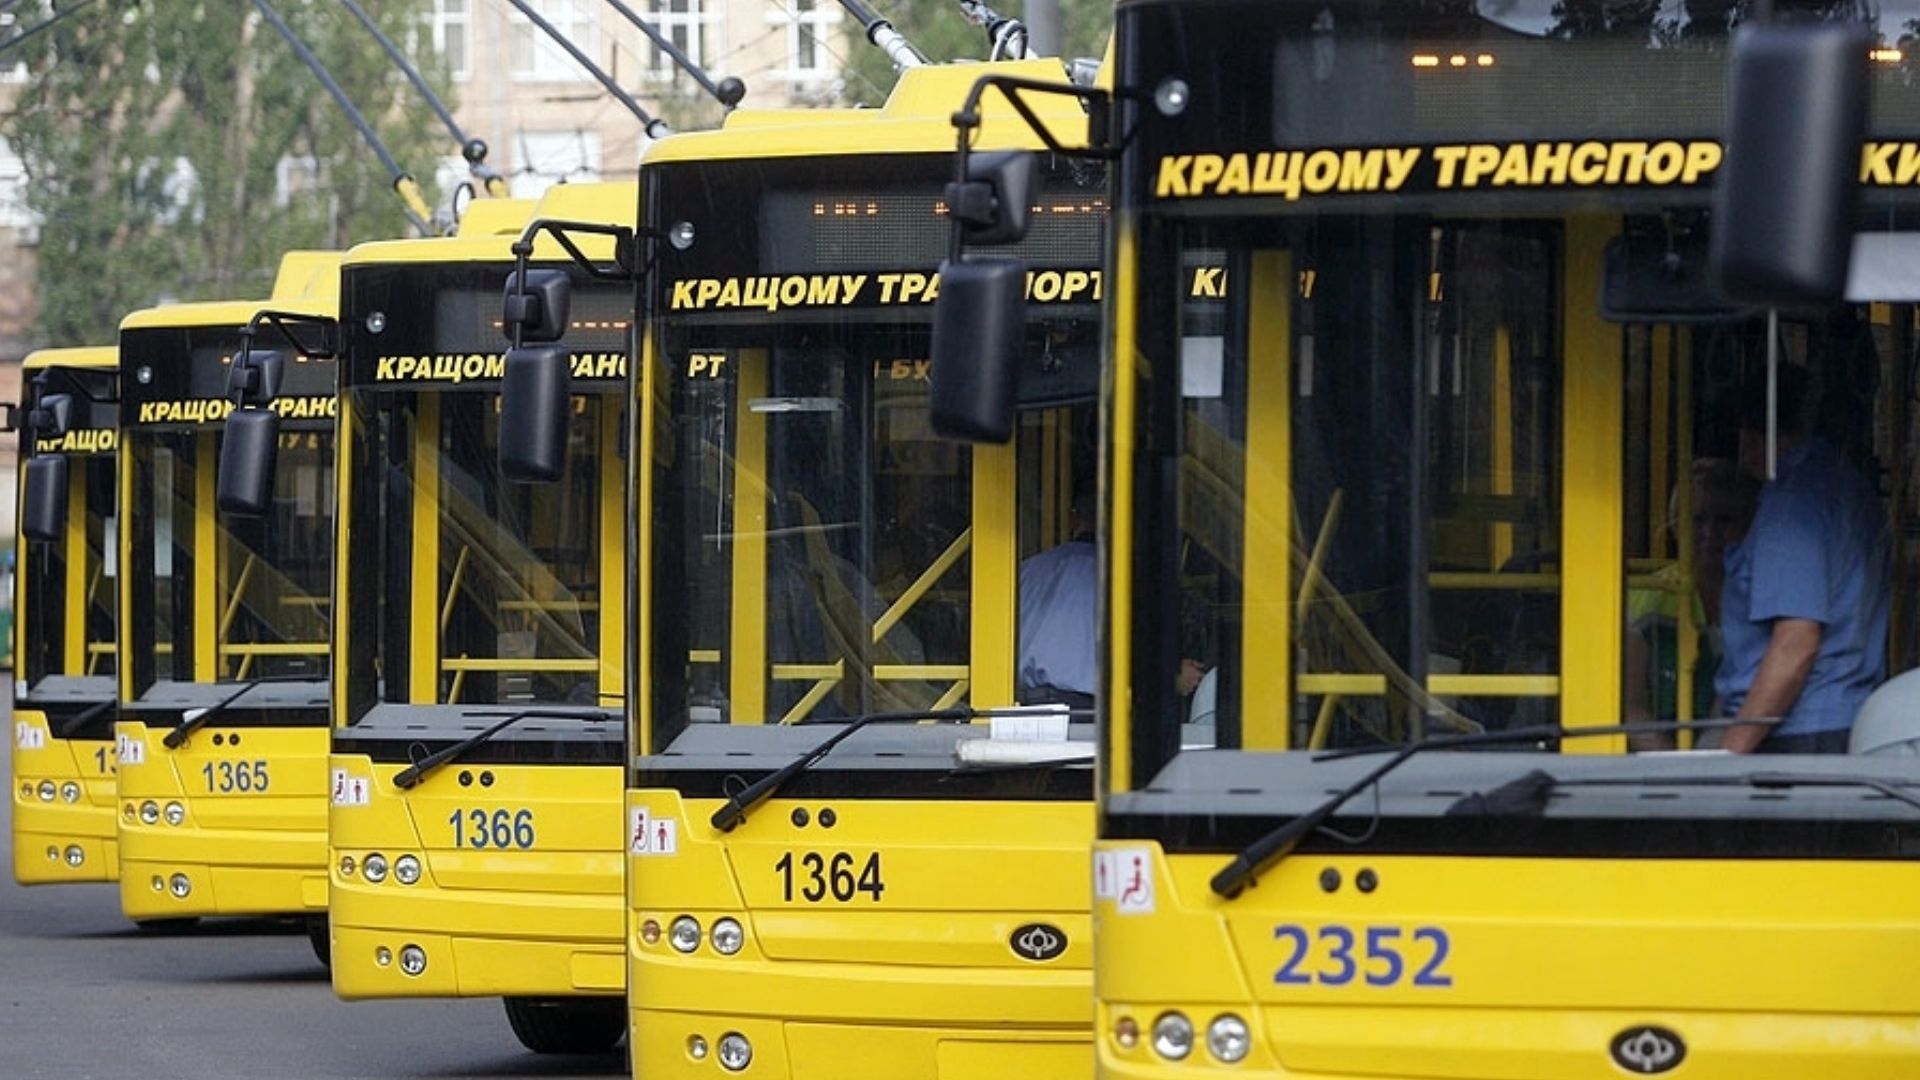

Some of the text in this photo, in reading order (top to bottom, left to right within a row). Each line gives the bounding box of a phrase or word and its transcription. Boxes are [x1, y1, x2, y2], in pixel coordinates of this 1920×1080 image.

[1156, 141, 1920, 200] КРАЩОМУ ТРАНСПОР КИ
[671, 274, 867, 312] КРАЩОМУ
[376, 353, 506, 383] КРАЩОМ
[139, 399, 236, 424] КРАЩО
[203, 761, 269, 792] 1365
[449, 808, 535, 849] 1366
[775, 851, 885, 902] 1364
[1273, 924, 1453, 986] 2352
